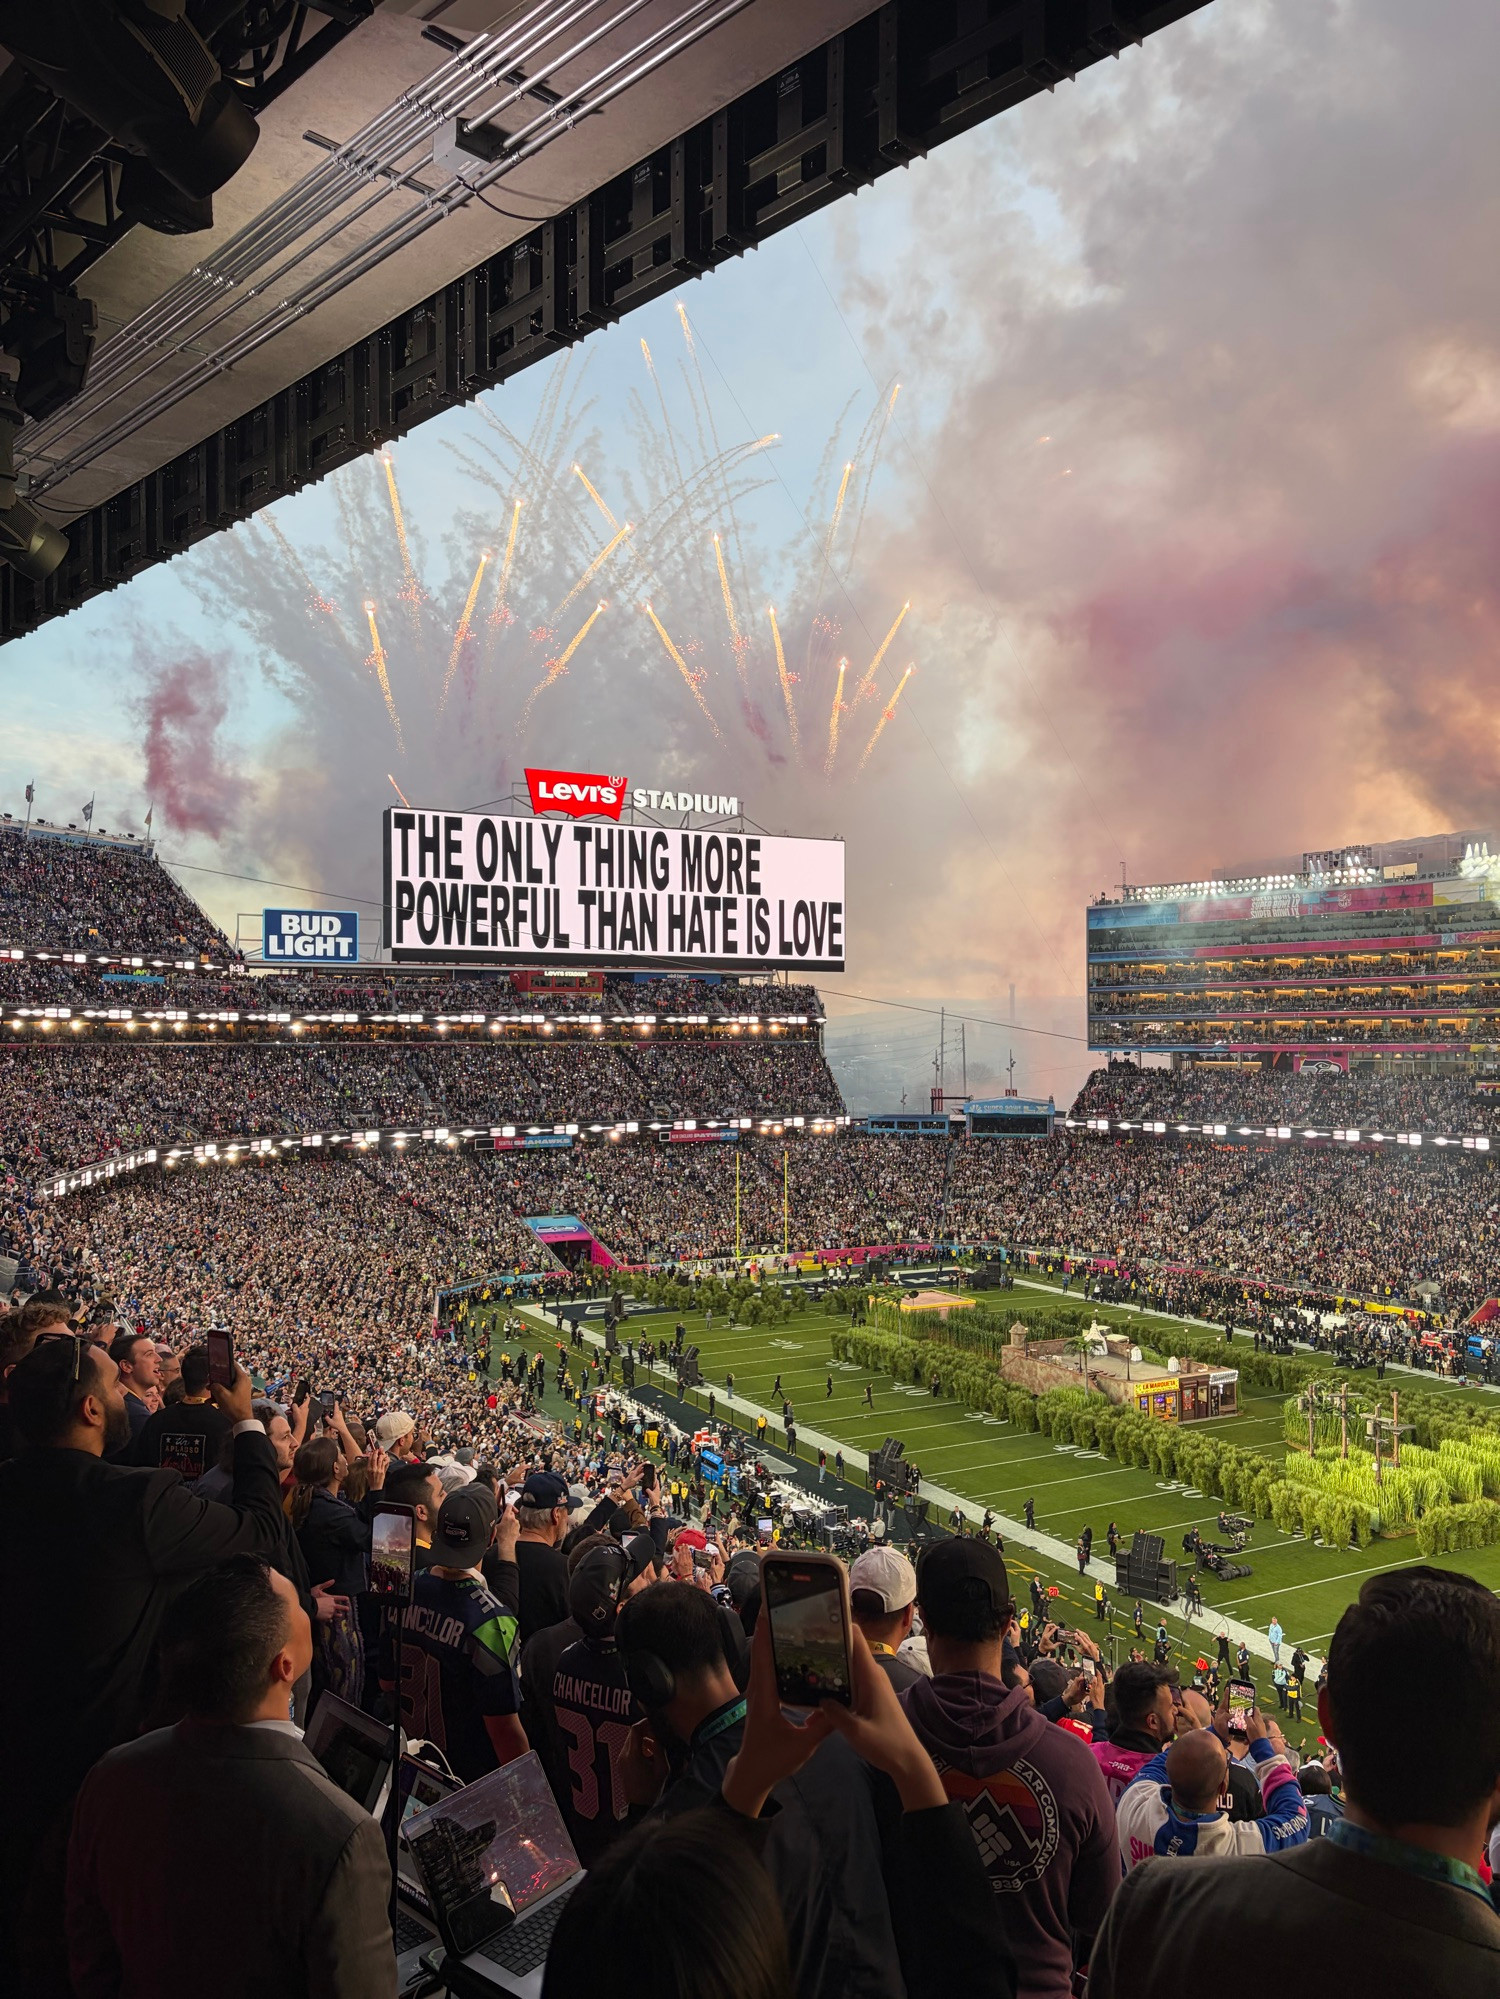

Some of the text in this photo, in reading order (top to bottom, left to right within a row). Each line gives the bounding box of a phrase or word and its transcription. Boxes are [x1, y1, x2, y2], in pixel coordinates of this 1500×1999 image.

[632, 788, 738, 815] STADIUM
[393, 813, 761, 896] THE ONLY THING MORE
[281, 914, 341, 936] BUD
[395, 880, 843, 957] POWERFUL THAN HATE IS LOVE
[268, 934, 353, 957] LIGHT
[1023, 1105, 1049, 1114] LX
[514, 1138, 570, 1146] SEAHAWKS
[682, 1260, 704, 1271] SUPR
[553, 1671, 632, 1716] CHANCELLOR
[554, 1705, 632, 1821] 31
[1013, 1760, 1057, 1876] EAR COMPANY
[1003, 1859, 1021, 1868] USA
[992, 1878, 1021, 1890] 938
